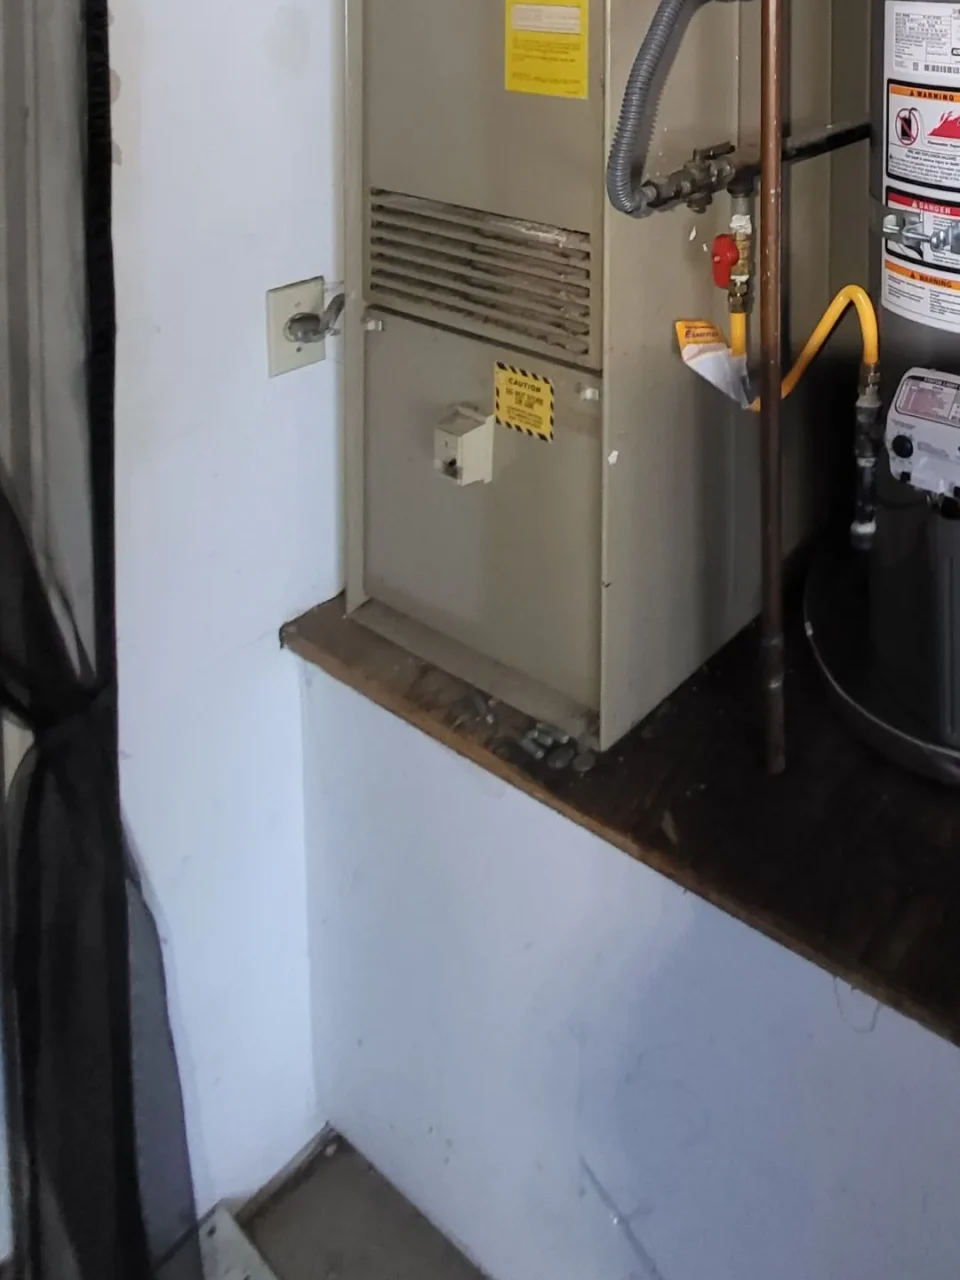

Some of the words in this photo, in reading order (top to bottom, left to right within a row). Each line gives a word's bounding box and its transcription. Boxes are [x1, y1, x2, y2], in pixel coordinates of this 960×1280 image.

[917, 91, 954, 102] WARNING
[919, 200, 952, 214] DANGER
[919, 275, 952, 288] WARNING
[508, 377, 541, 392] CAUTION
